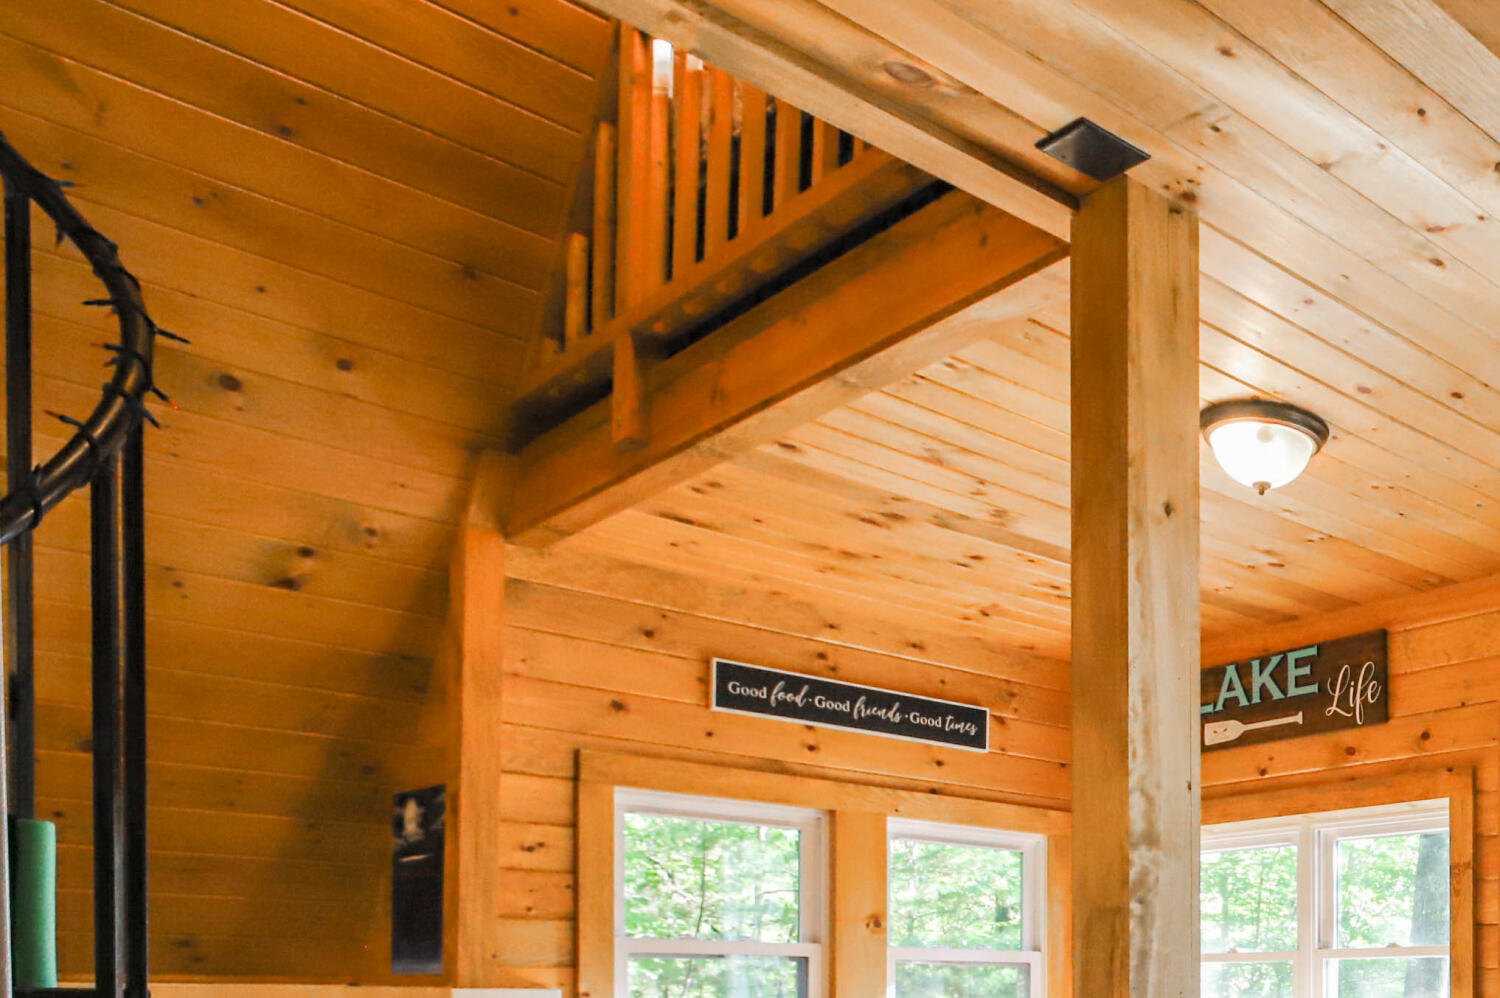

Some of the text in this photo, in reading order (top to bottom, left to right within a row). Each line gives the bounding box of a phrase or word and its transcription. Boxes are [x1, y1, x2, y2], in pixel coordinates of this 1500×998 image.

[727, 681, 978, 736] Good food Good friends Good times
[1325, 661, 1381, 725] Life
